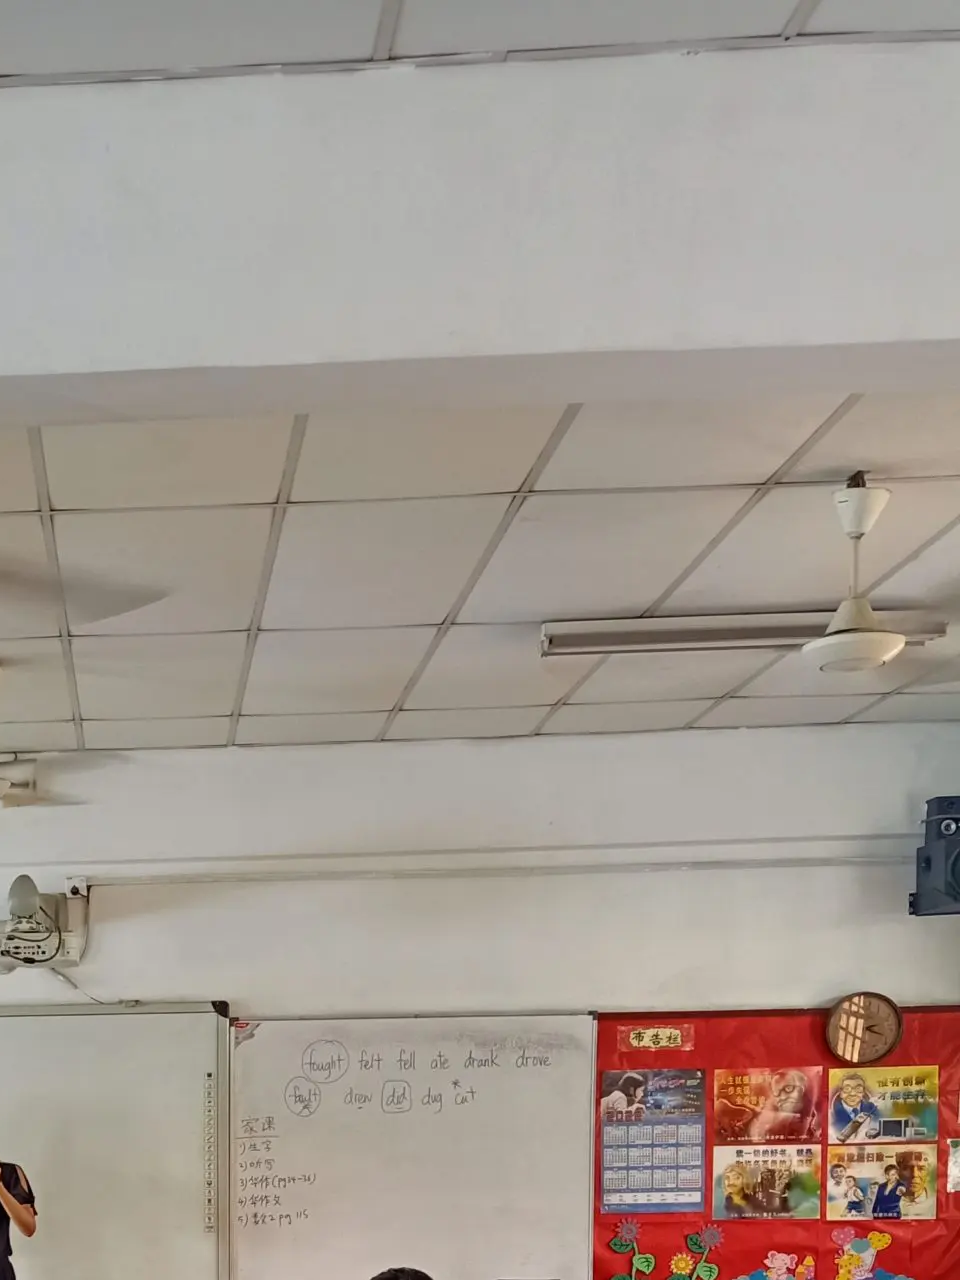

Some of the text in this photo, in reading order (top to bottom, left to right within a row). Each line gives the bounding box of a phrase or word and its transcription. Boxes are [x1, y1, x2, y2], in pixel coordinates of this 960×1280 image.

[631, 1030, 681, 1046] 布告栏
[304, 1048, 552, 1080] fought felt fell ate drank drove
[385, 1086, 408, 1106] did
[421, 1086, 443, 1114] dug
[454, 1087, 477, 1106] cut
